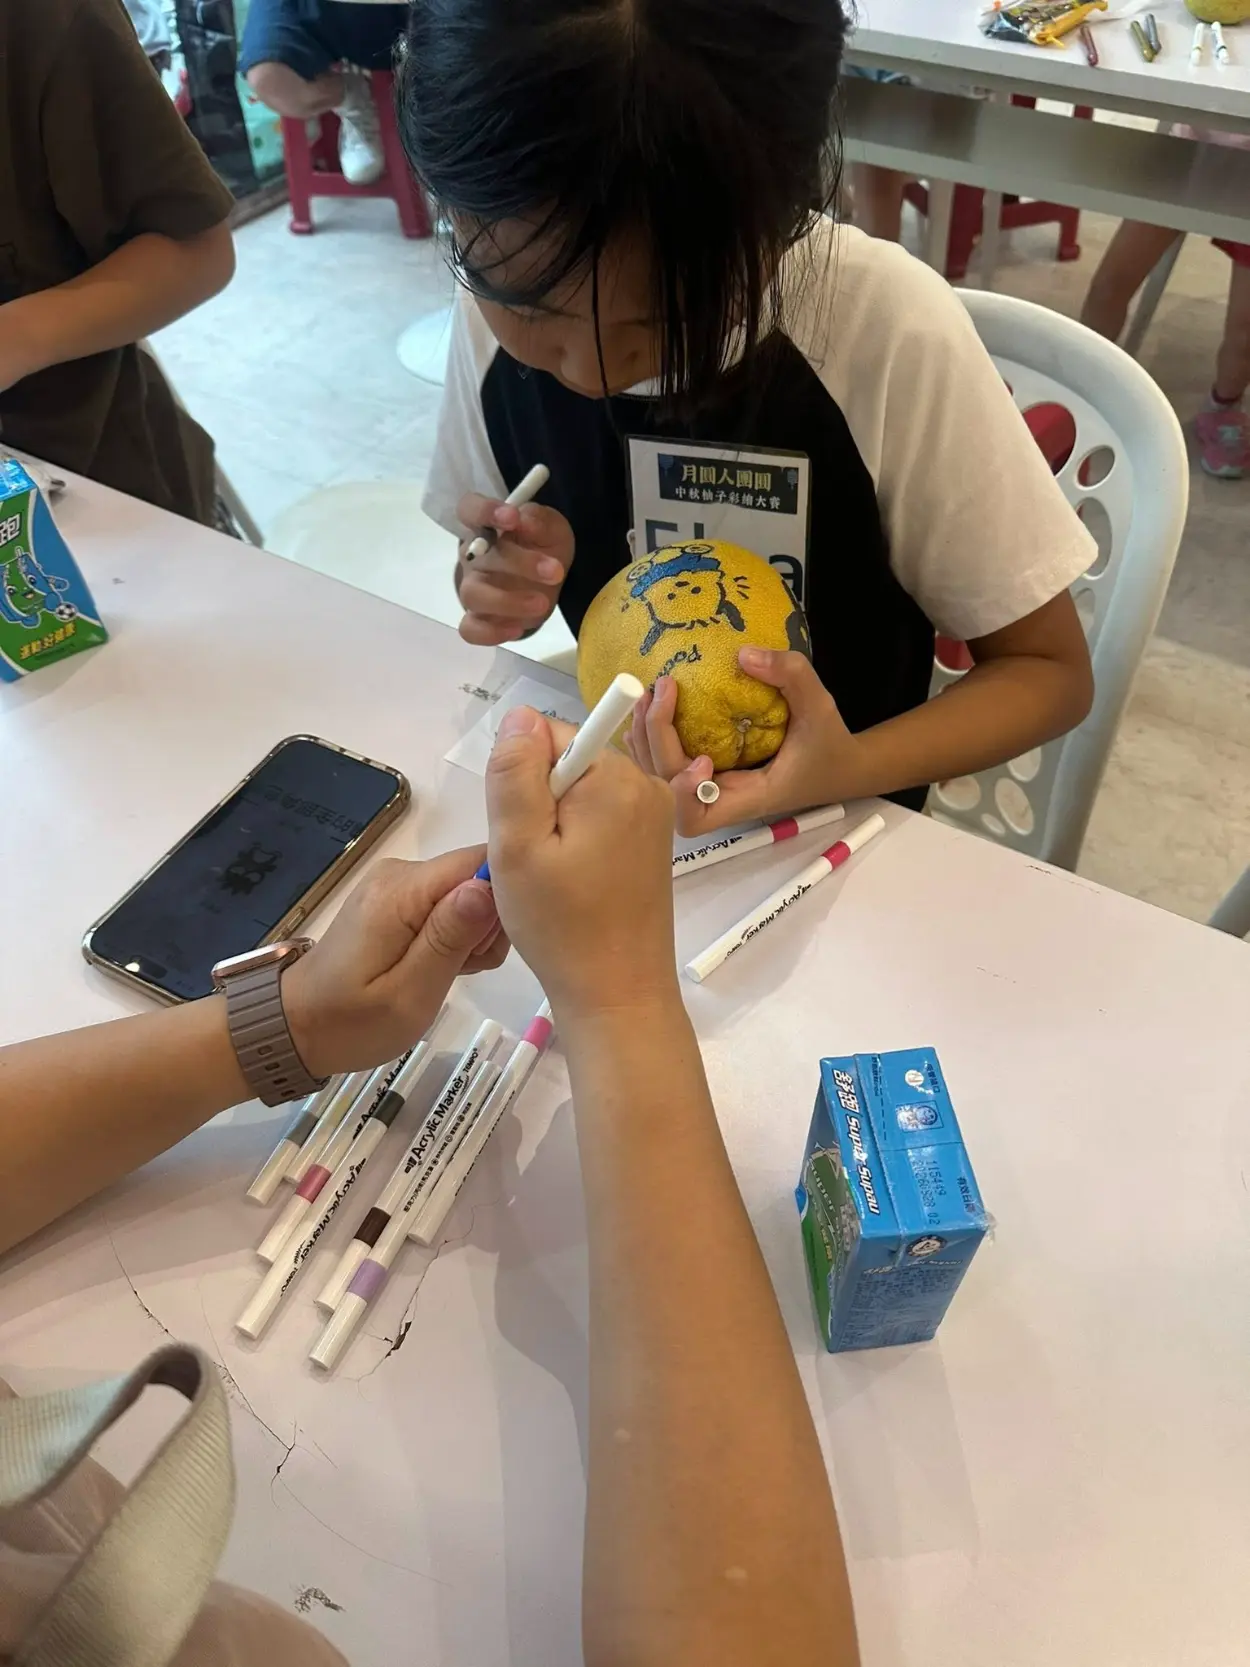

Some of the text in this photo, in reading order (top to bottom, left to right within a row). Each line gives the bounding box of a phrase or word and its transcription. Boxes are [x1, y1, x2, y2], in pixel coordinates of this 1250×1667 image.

[681, 464, 772, 492] 月圓人團圓
[675, 486, 781, 510] 中秋柚子彩繪大賽
[696, 839, 729, 858] Acrylic
[774, 889, 801, 916] Acrylic
[746, 913, 775, 941] Marker
[411, 1117, 441, 1160] Acrylic
[434, 1076, 464, 1118] Marker
[832, 1069, 860, 1113] 舒跑
[858, 1164, 880, 1215] Supau
[327, 1172, 357, 1215] Acrylic
[928, 1212, 941, 1225] 02
[300, 1214, 331, 1262] Marker
